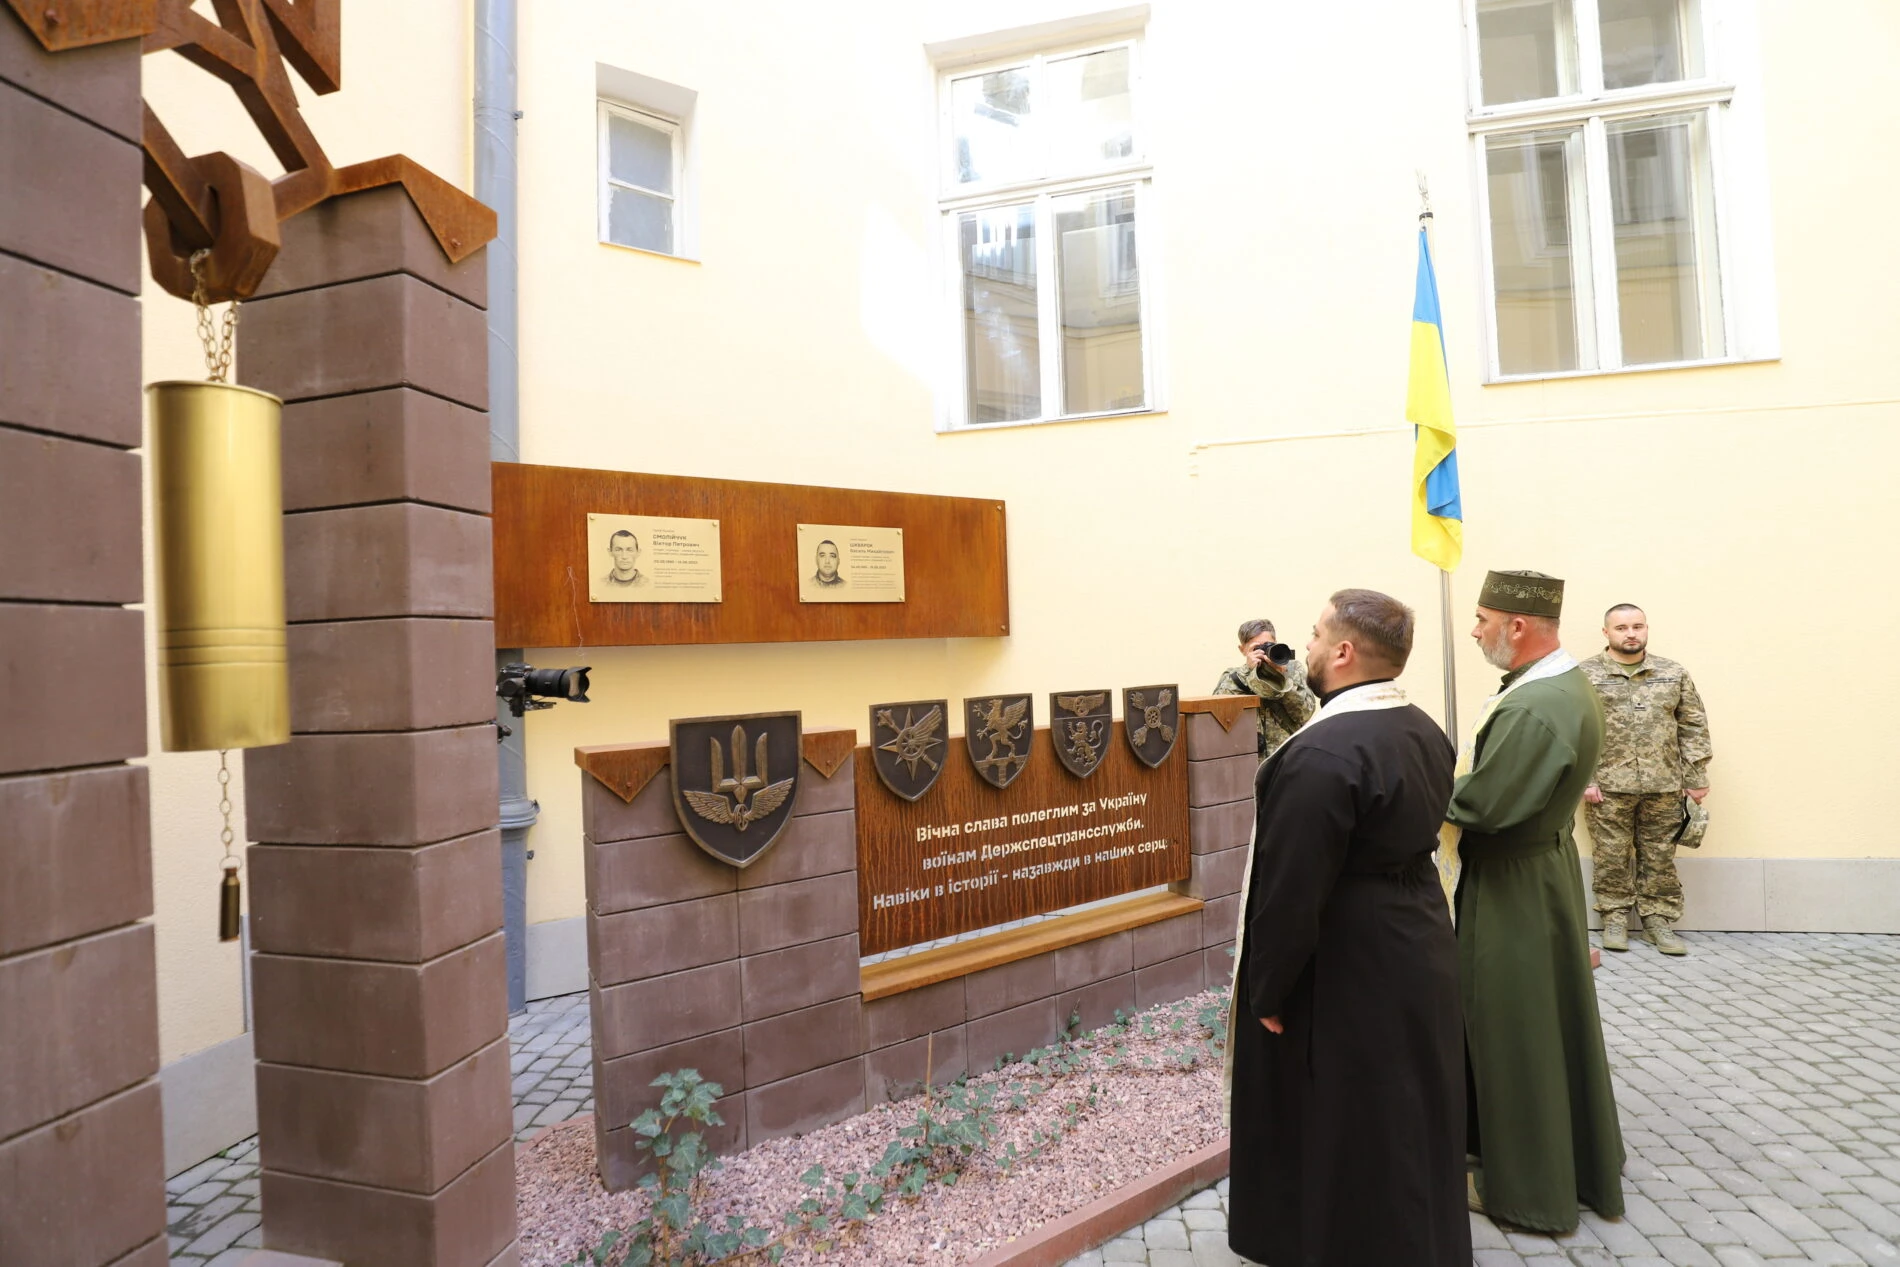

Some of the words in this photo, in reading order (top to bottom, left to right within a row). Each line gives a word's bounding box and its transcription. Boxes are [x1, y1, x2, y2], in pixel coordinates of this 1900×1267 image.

[916, 823, 960, 843] Вічна
[964, 815, 1008, 834] слава
[1012, 804, 1079, 825] полеглим
[1082, 802, 1096, 817] за
[1099, 792, 1148, 811] Україну
[922, 849, 977, 871] воїнам
[981, 818, 1145, 862] Держспецтрансслужби.
[873, 887, 930, 910] Навіки
[934, 883, 944, 897] в
[948, 870, 998, 895] історії
[1012, 855, 1080, 880] назавжди
[1084, 852, 1091, 865] в
[1094, 845, 1135, 862] наших
[1137, 836, 1176, 854] серц
